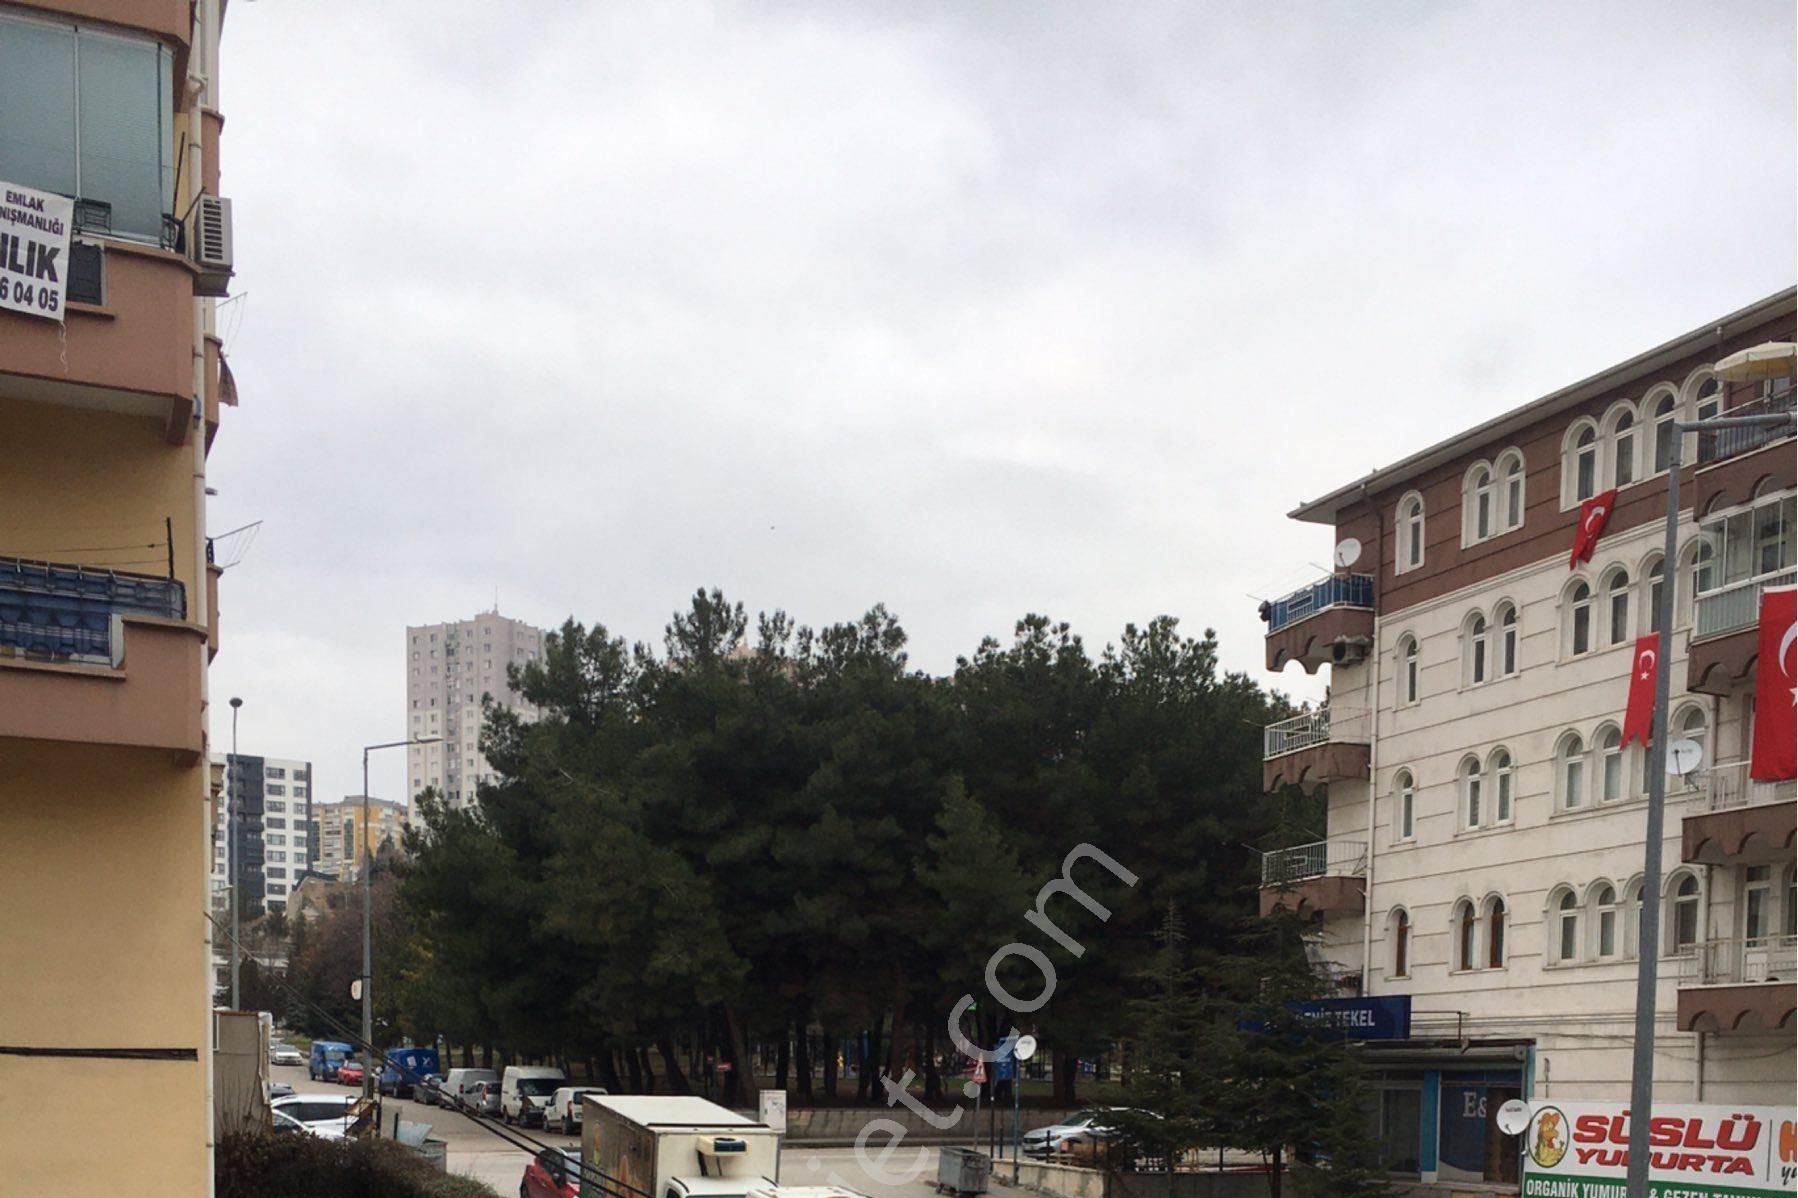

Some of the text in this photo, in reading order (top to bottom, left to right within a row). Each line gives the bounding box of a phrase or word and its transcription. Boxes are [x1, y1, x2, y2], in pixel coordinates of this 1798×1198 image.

[6, 189, 45, 213] EMLAK
[13, 281, 34, 306] 04
[38, 287, 59, 312] 05
[1335, 1010, 1375, 1027] TEKEL
[1525, 1178, 1579, 1198] ORGANİK
